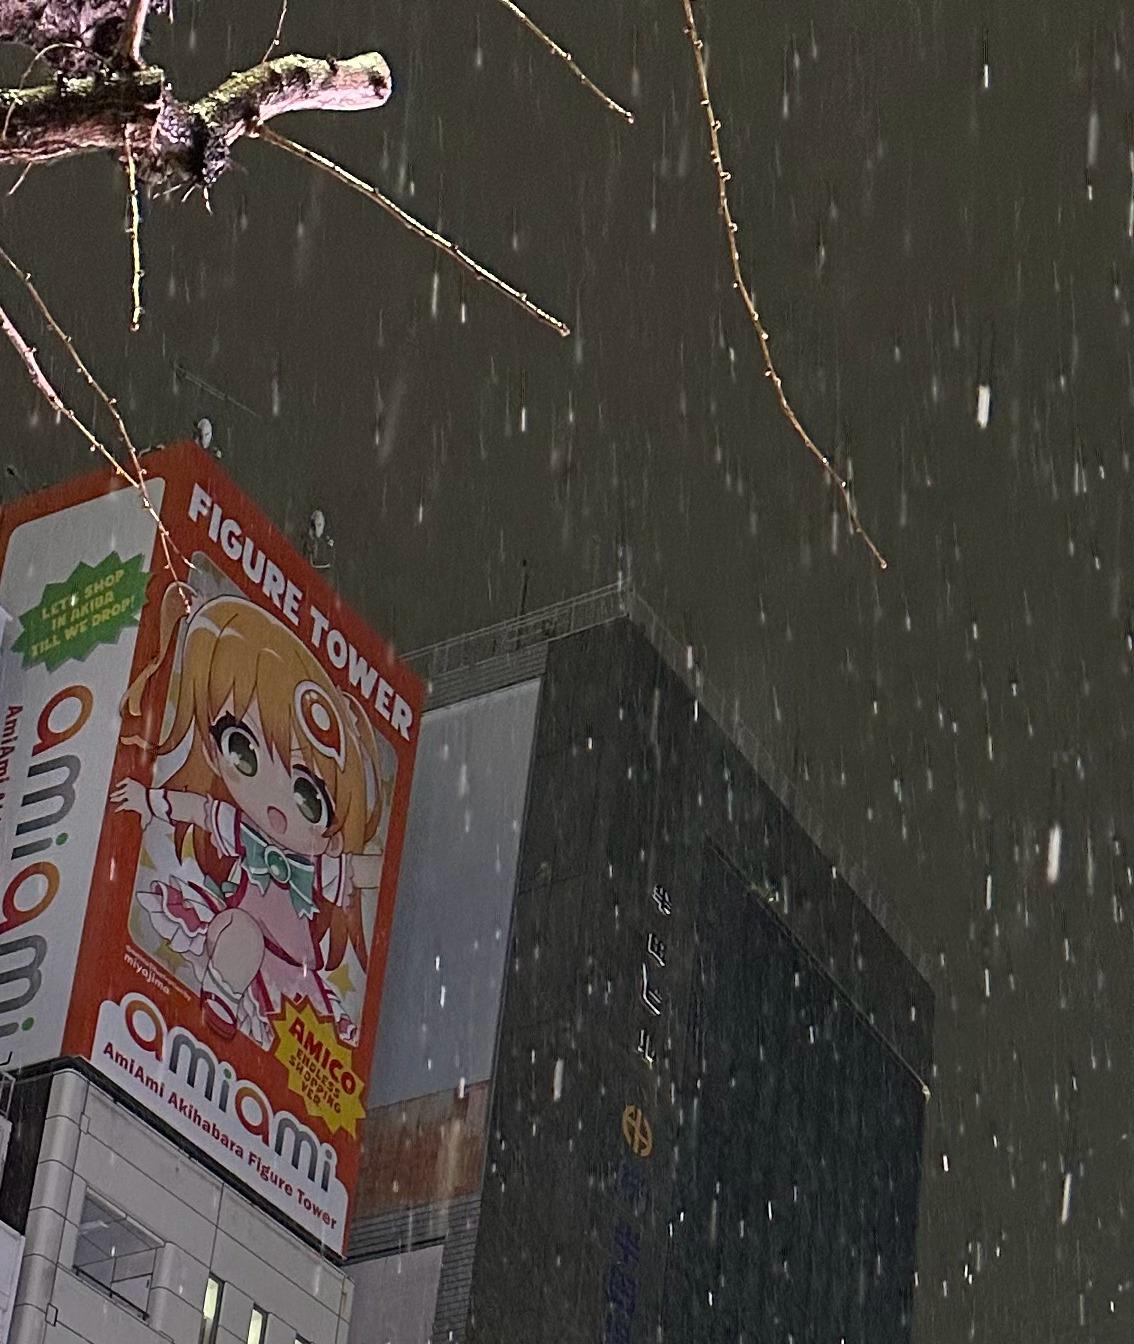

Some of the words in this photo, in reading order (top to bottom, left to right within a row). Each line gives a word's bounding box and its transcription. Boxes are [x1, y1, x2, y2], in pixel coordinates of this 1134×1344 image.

[84, 569, 125, 598] SHOP
[188, 482, 303, 626] FIGURE
[308, 605, 414, 741] TOWER
[30, 634, 61, 658] TILL
[64, 619, 88, 641] WE
[52, 617, 66, 632] IN
[123, 953, 171, 995] miyajima
[288, 1016, 356, 1096] AMICO
[125, 997, 335, 1193] amiami
[103, 1042, 166, 1099] AmiAmi
[167, 1091, 245, 1159] Akihabara
[247, 1150, 294, 1198] Figure
[297, 1188, 338, 1231] Tower
